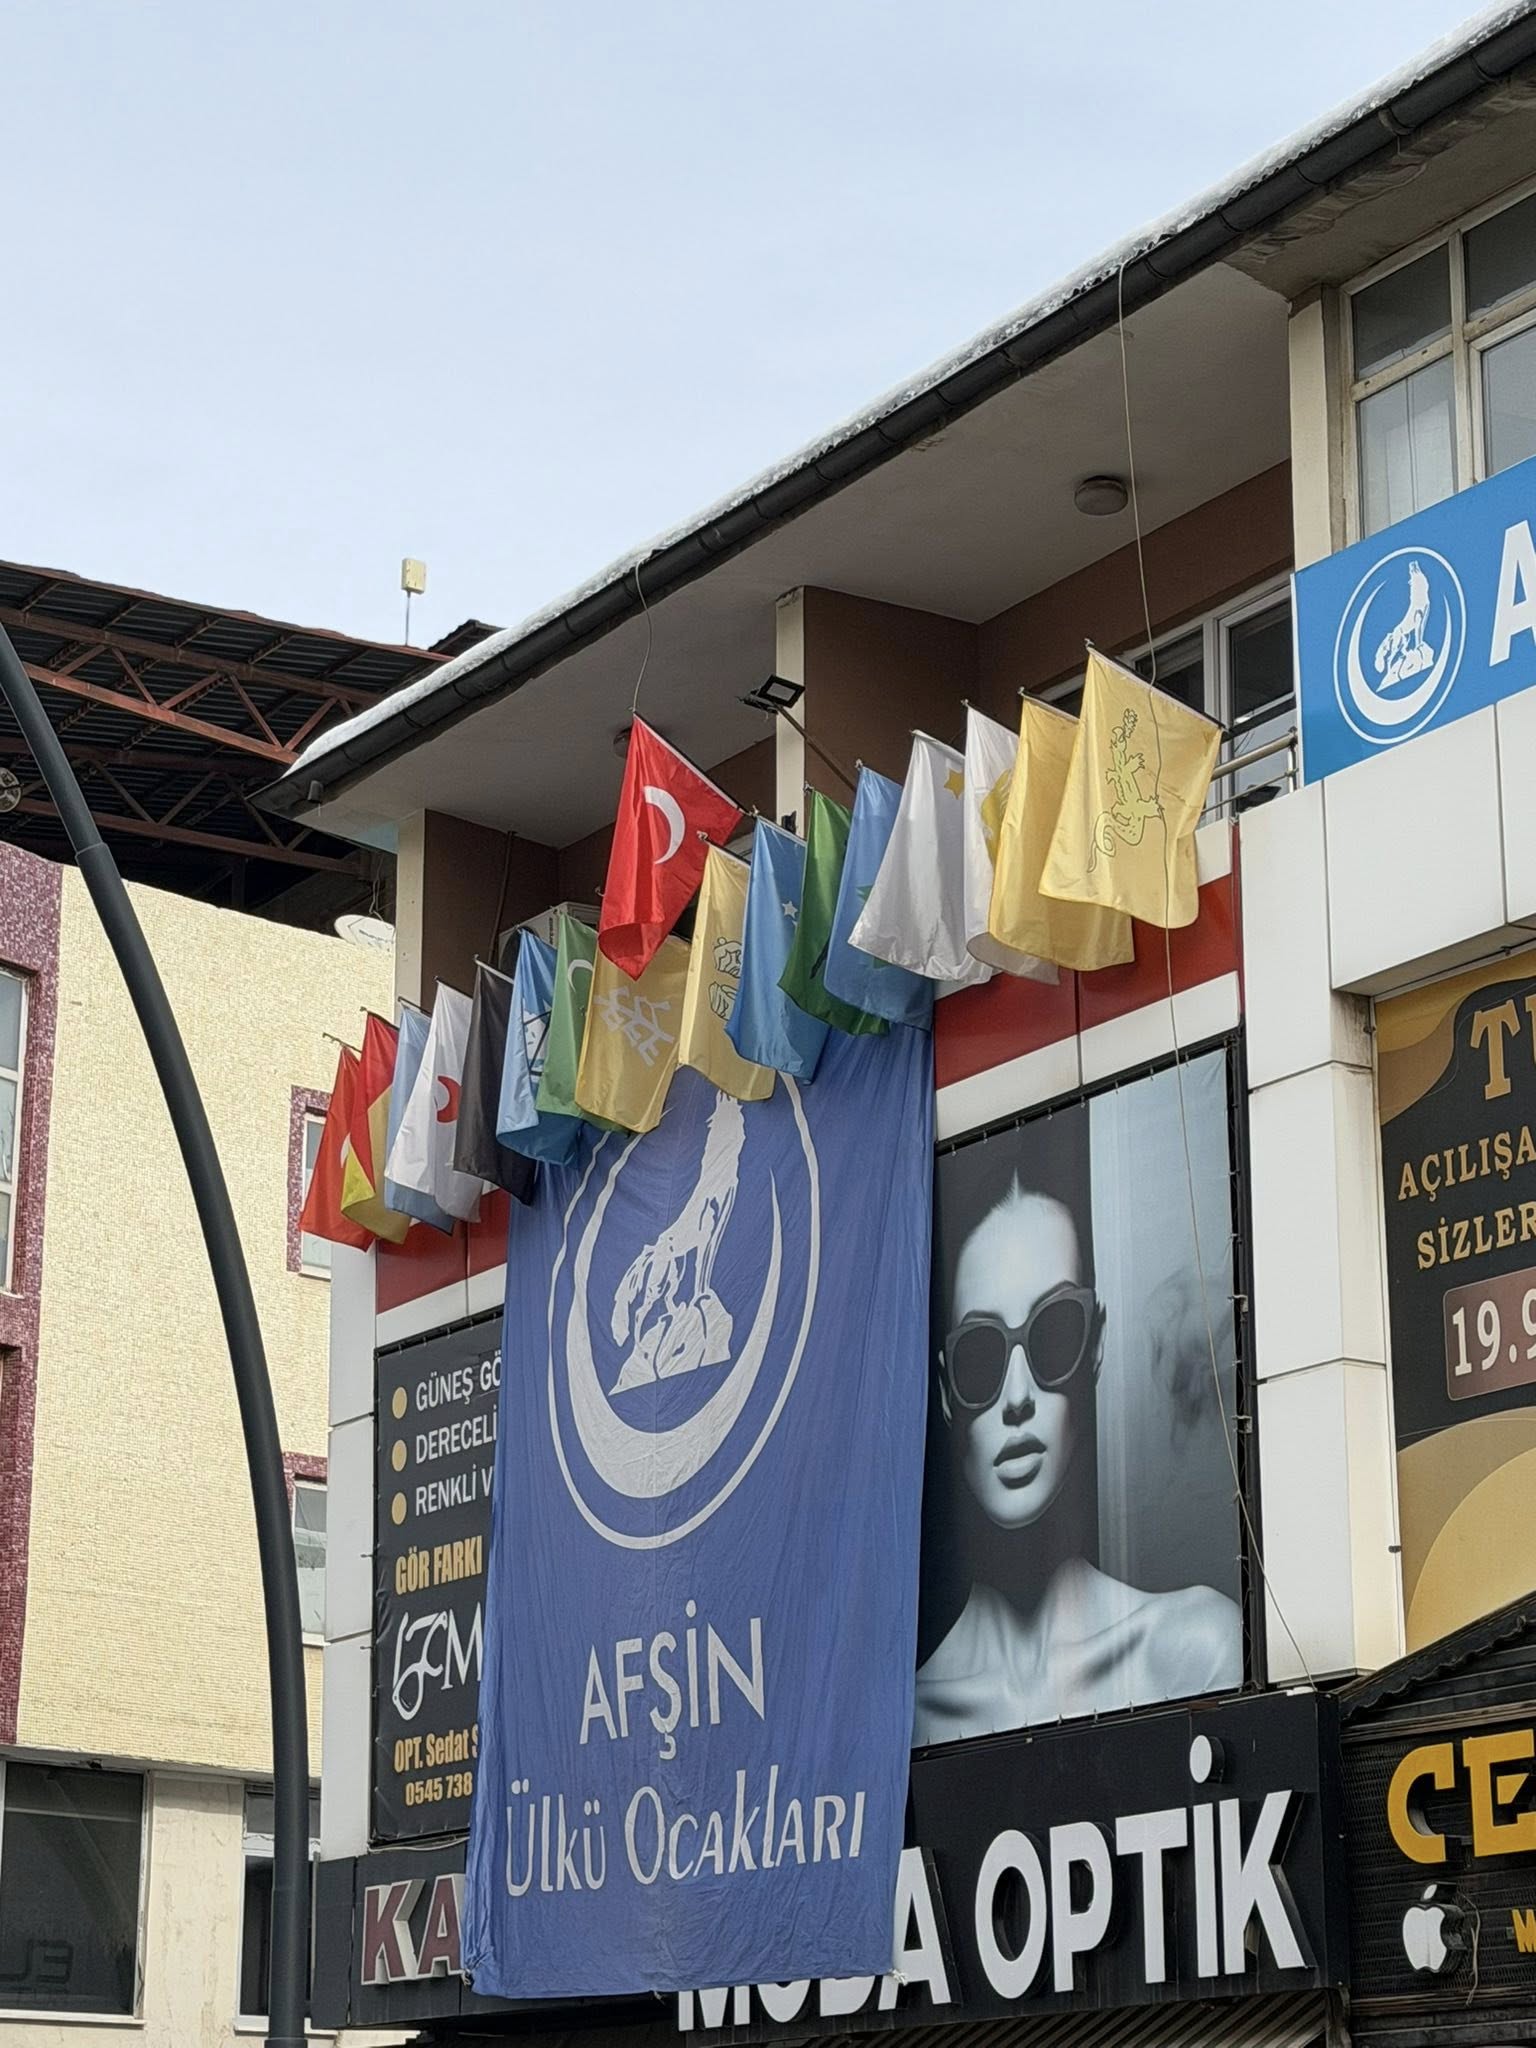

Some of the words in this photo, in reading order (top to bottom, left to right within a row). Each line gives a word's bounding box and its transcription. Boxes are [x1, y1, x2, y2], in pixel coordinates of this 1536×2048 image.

[1398, 1125, 1536, 1202] AÇILIŞA
[416, 1367, 474, 1412] GÜNEŞ
[415, 1405, 498, 1464] DERECELİ
[415, 1464, 477, 1516] RENKLİ
[395, 1546, 430, 1595] GÖR
[433, 1535, 483, 1585] FARKI
[579, 1599, 765, 1760] AFŞİN
[394, 1736, 424, 1773] OPT.
[426, 1729, 469, 1767] Sedat
[405, 1777, 443, 1806] 0545
[445, 1771, 473, 1799] 738
[975, 1735, 1307, 1999] OPTİK
[361, 1873, 465, 1986] KA
